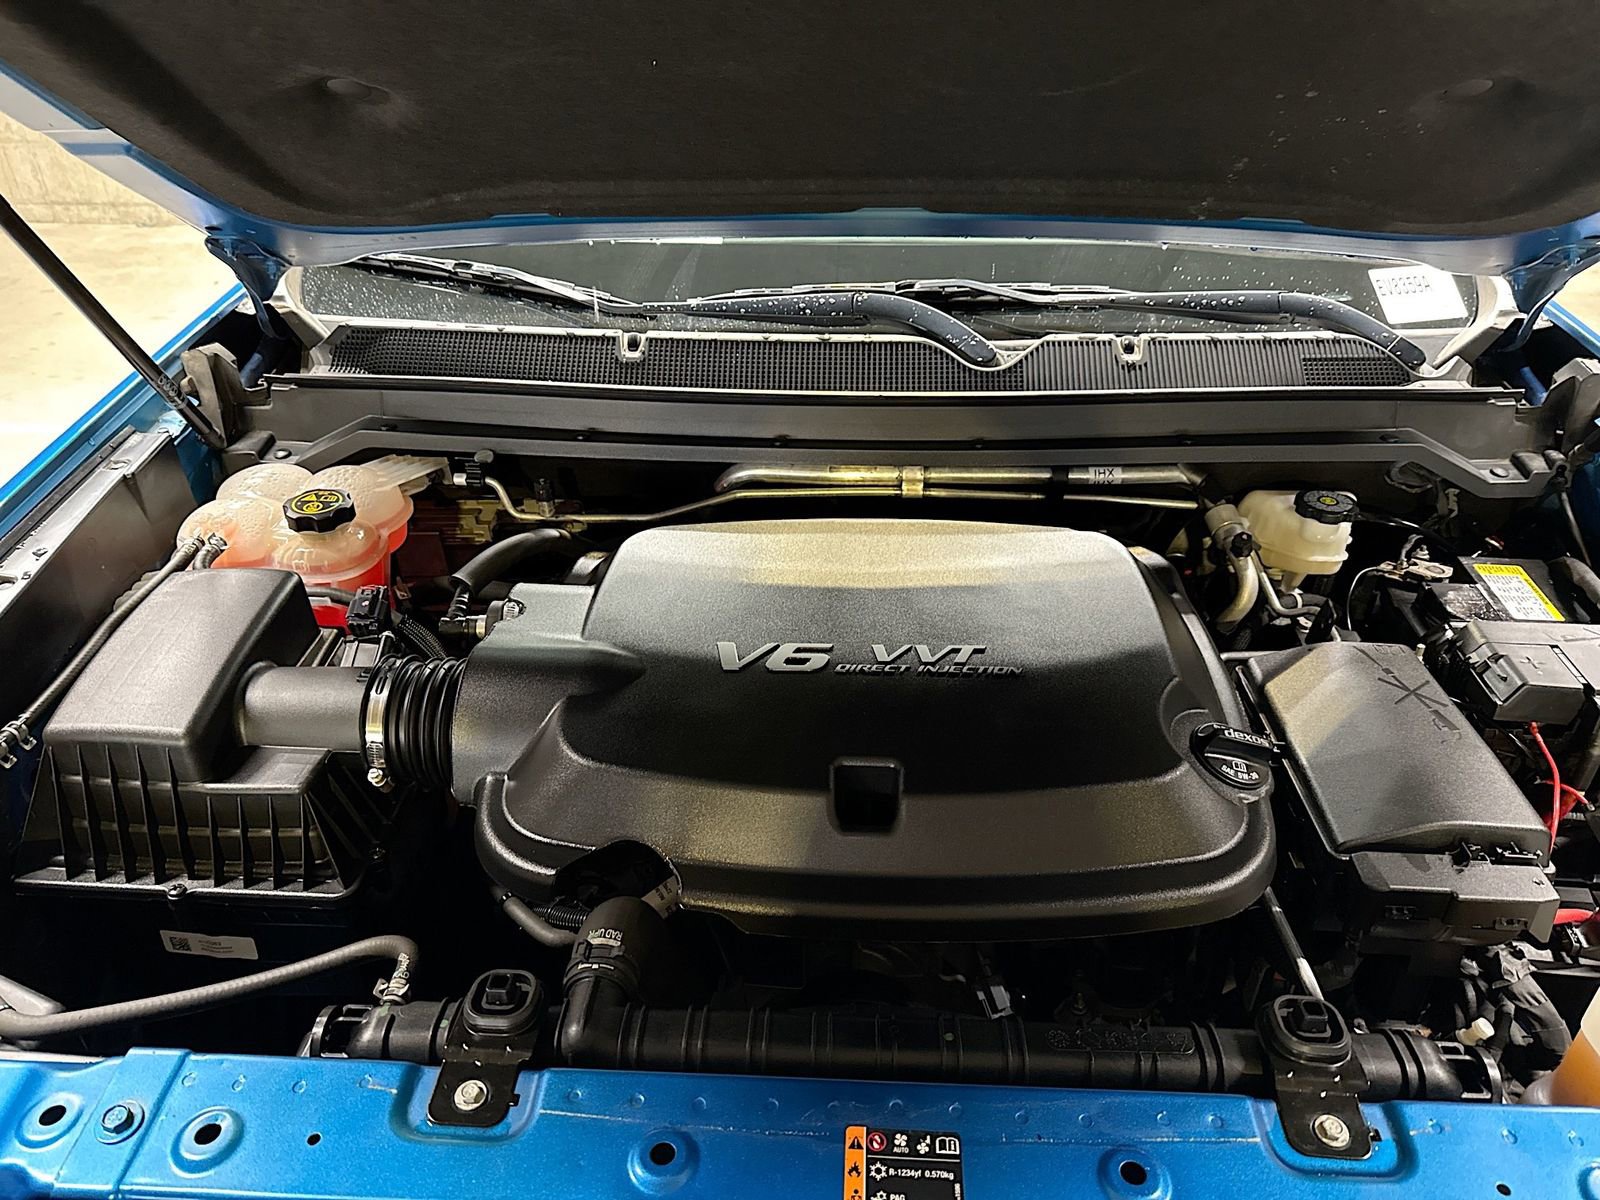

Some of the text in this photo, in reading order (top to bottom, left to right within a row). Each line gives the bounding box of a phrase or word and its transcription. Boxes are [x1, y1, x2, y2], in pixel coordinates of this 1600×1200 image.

[716, 641, 987, 671] V6 VVT
[834, 663, 1024, 676] DIRECT INJECTION
[1221, 764, 1235, 776] SAE
[605, 929, 623, 940] RAD
[888, 1168, 954, 1180] R-1234yf 0.570kg
